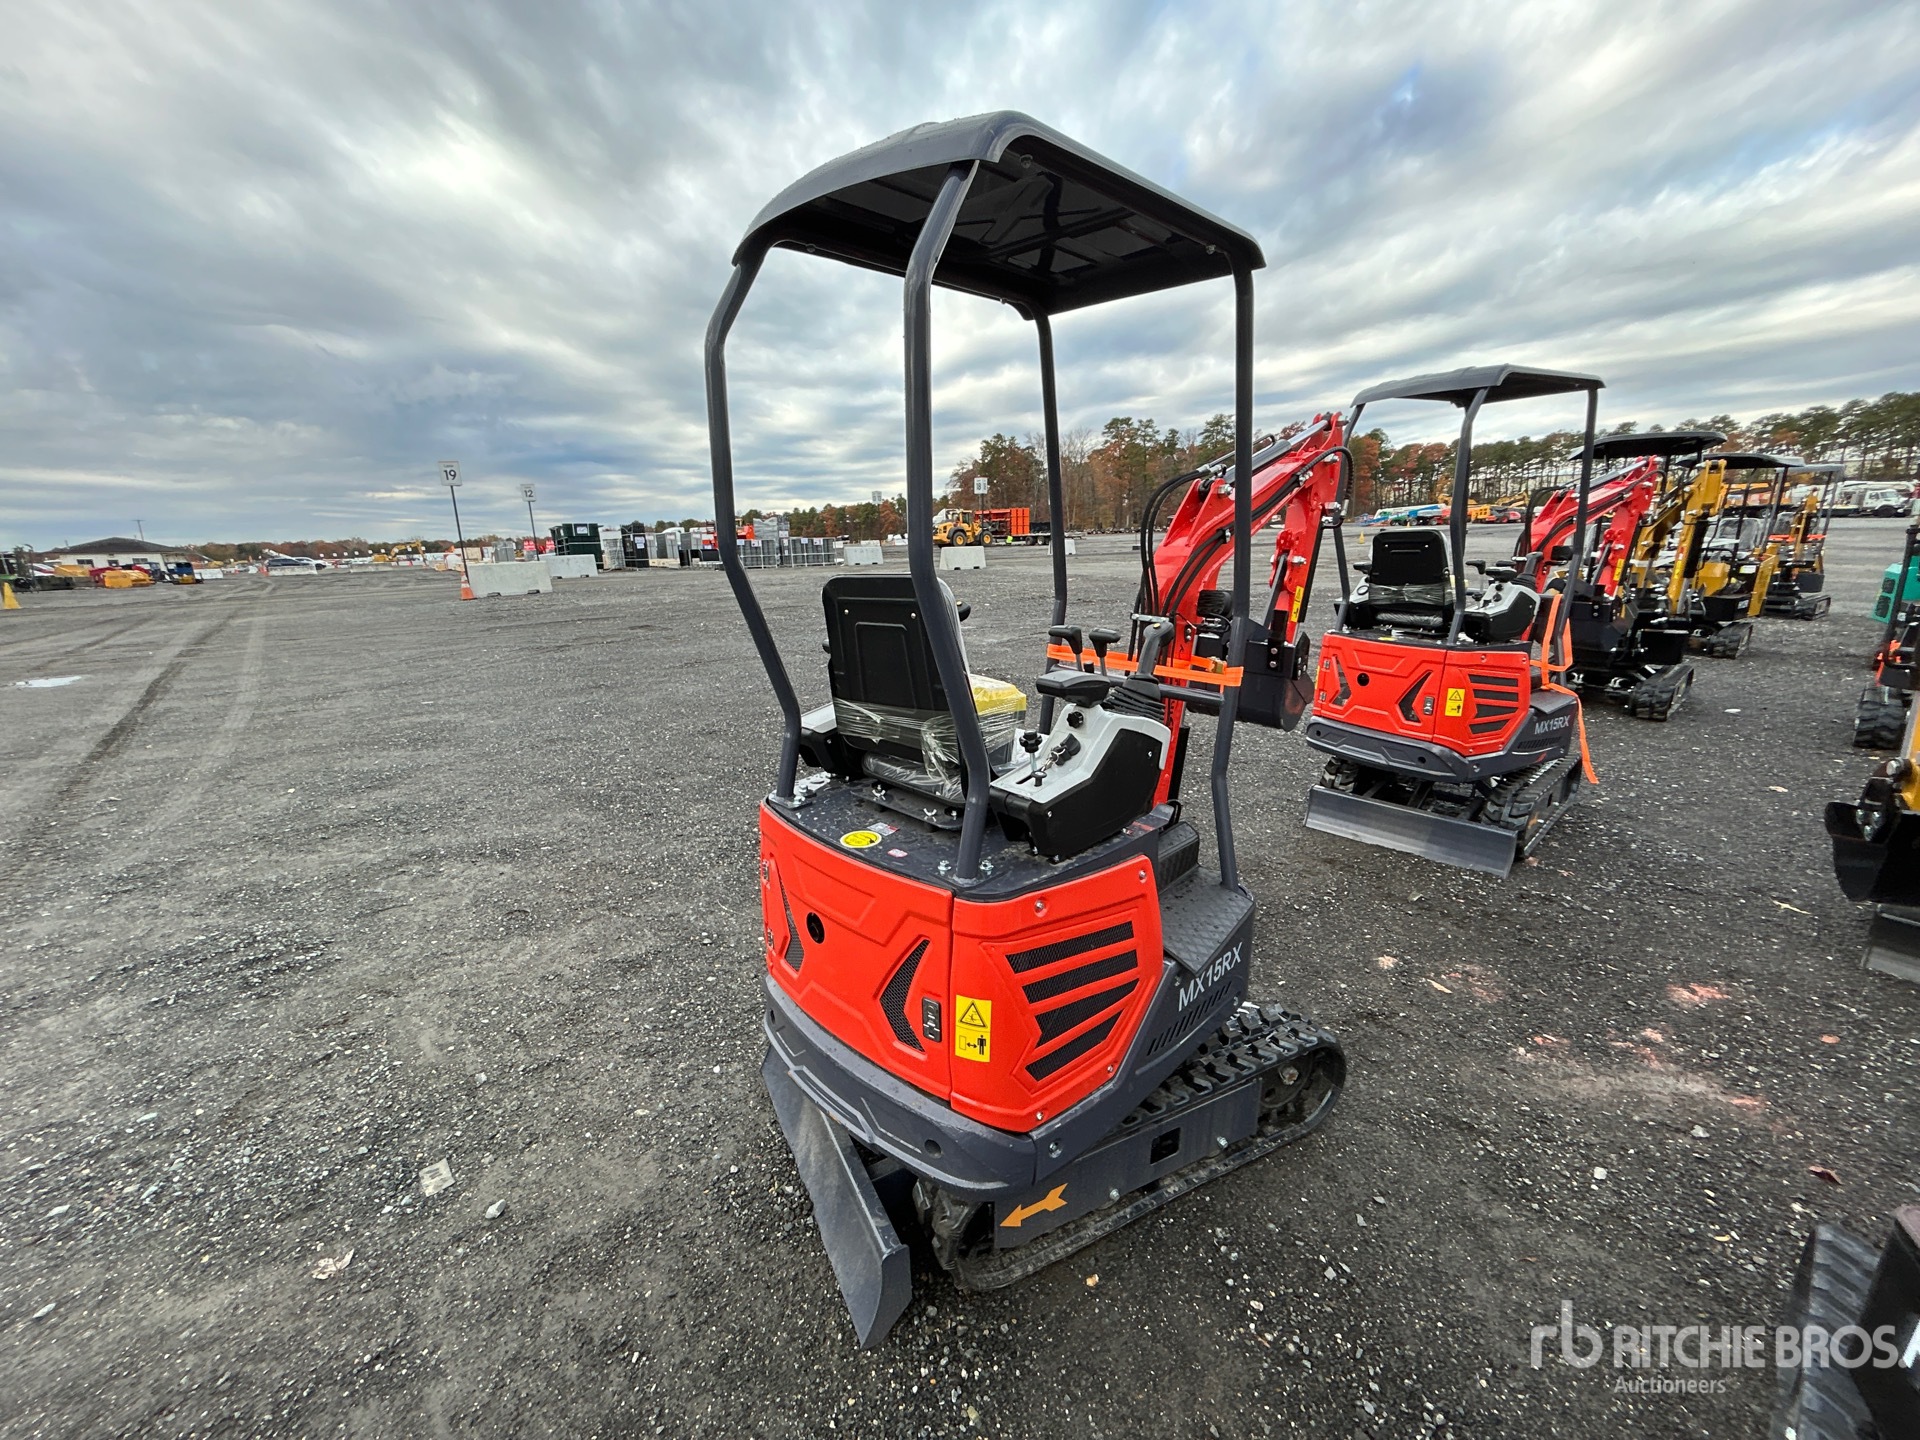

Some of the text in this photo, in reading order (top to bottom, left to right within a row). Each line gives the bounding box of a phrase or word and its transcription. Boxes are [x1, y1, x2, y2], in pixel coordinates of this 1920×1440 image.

[443, 469, 457, 481] 19
[524, 489, 534, 498] 12
[1534, 715, 1571, 735] MX15RX
[1178, 941, 1243, 1012] MX15RX
